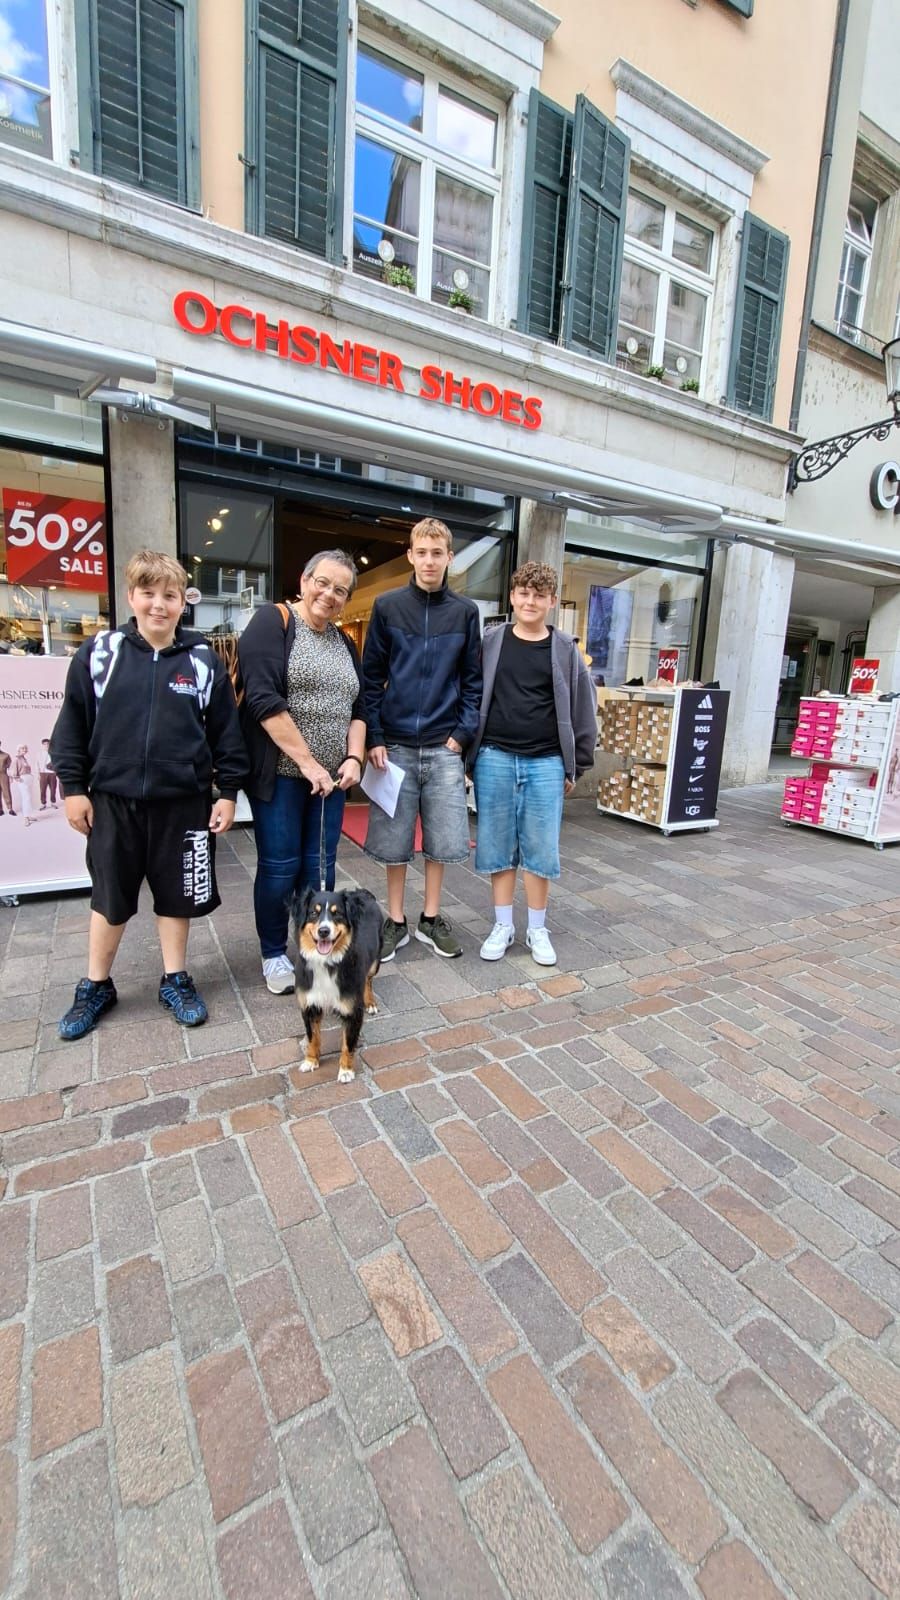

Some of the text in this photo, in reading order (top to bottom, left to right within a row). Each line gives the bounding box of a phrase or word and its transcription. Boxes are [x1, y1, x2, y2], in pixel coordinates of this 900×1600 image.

[172, 290, 543, 431] OCHSNER SHOES
[8, 508, 104, 556] 50%
[59, 556, 104, 576] SALE
[658, 658, 678, 670] 50%
[852, 667, 878, 679] 50%
[694, 725, 711, 733] BOSS
[685, 805, 701, 816] UGG
[184, 851, 193, 896] DES RUES
[194, 840, 208, 905] BOXEUR
